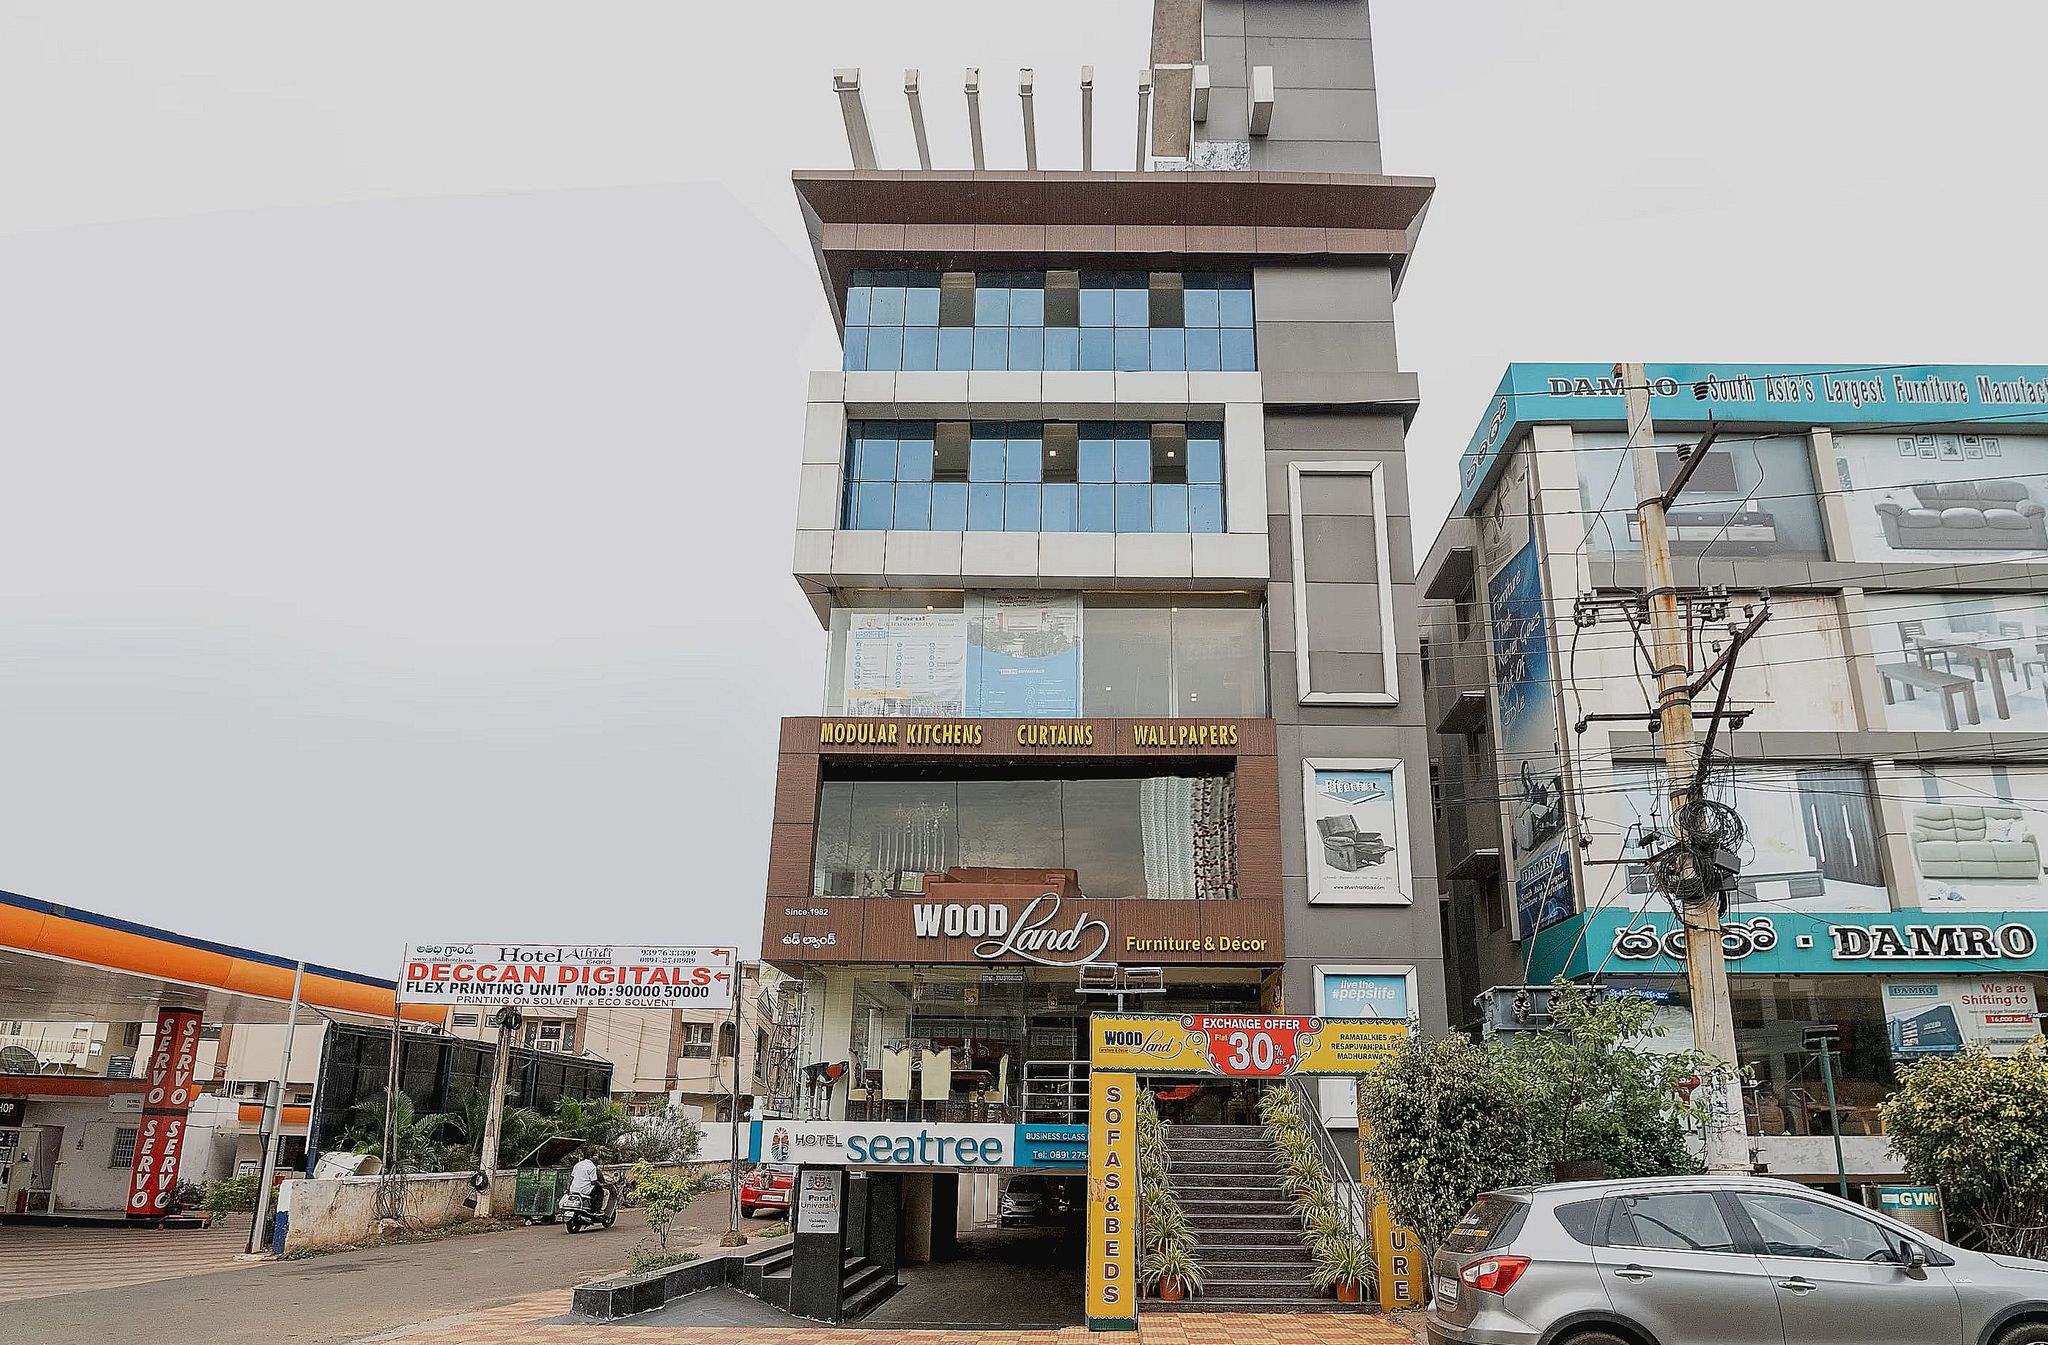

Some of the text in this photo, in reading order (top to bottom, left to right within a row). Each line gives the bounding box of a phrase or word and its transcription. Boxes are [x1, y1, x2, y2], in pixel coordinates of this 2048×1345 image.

[1549, 378, 1680, 398] DAMO
[1707, 372, 1755, 402] South
[1765, 374, 1814, 403] Asia's
[1822, 374, 1886, 408] Largest
[1893, 375, 1969, 404] Furniture
[820, 723, 983, 745] MODULAR KITCHENS
[1017, 724, 1094, 745] CURTAINS
[1133, 724, 1239, 746] WALLPAPERS
[913, 892, 1110, 966] WOOD Land
[1126, 936, 1267, 951] Furniture & Décor
[1831, 923, 2038, 960] DAMRO
[498, 947, 614, 963] Hotel Athidi
[407, 963, 711, 986] DECCAN DIGITALS
[1340, 980, 1375, 989] live the
[405, 981, 445, 994] FLEX
[449, 982, 525, 995] PRINTING
[529, 984, 568, 996] UNIT
[664, 986, 710, 998] 50000
[1331, 986, 1396, 1001] #pepslife
[1894, 986, 1934, 995] DAMRO
[1982, 984, 2026, 993] We are
[456, 996, 677, 1007] PRINTING ON SOLVENT & ECO SOLVENT
[1961, 995, 2028, 1007] Shifting to
[1203, 1018, 1300, 1030] EXCHANGE OFFER
[1104, 1029, 1184, 1059] WOOD Land
[1340, 1033, 1388, 1041] RAMATALKIES
[149, 1018, 175, 1105] SERVO
[170, 1019, 197, 1106] SERVO
[1025, 1132, 1061, 1140] BUSINESS
[795, 1129, 1003, 1164] HOTEL seatree
[1032, 1151, 1048, 1159] Tel:
[1049, 1151, 1070, 1159] 0891
[131, 1120, 158, 1209] SERVO
[154, 1120, 182, 1209] SERVO
[800, 1201, 838, 1210] University
[1390, 1218, 1411, 1301] URE
